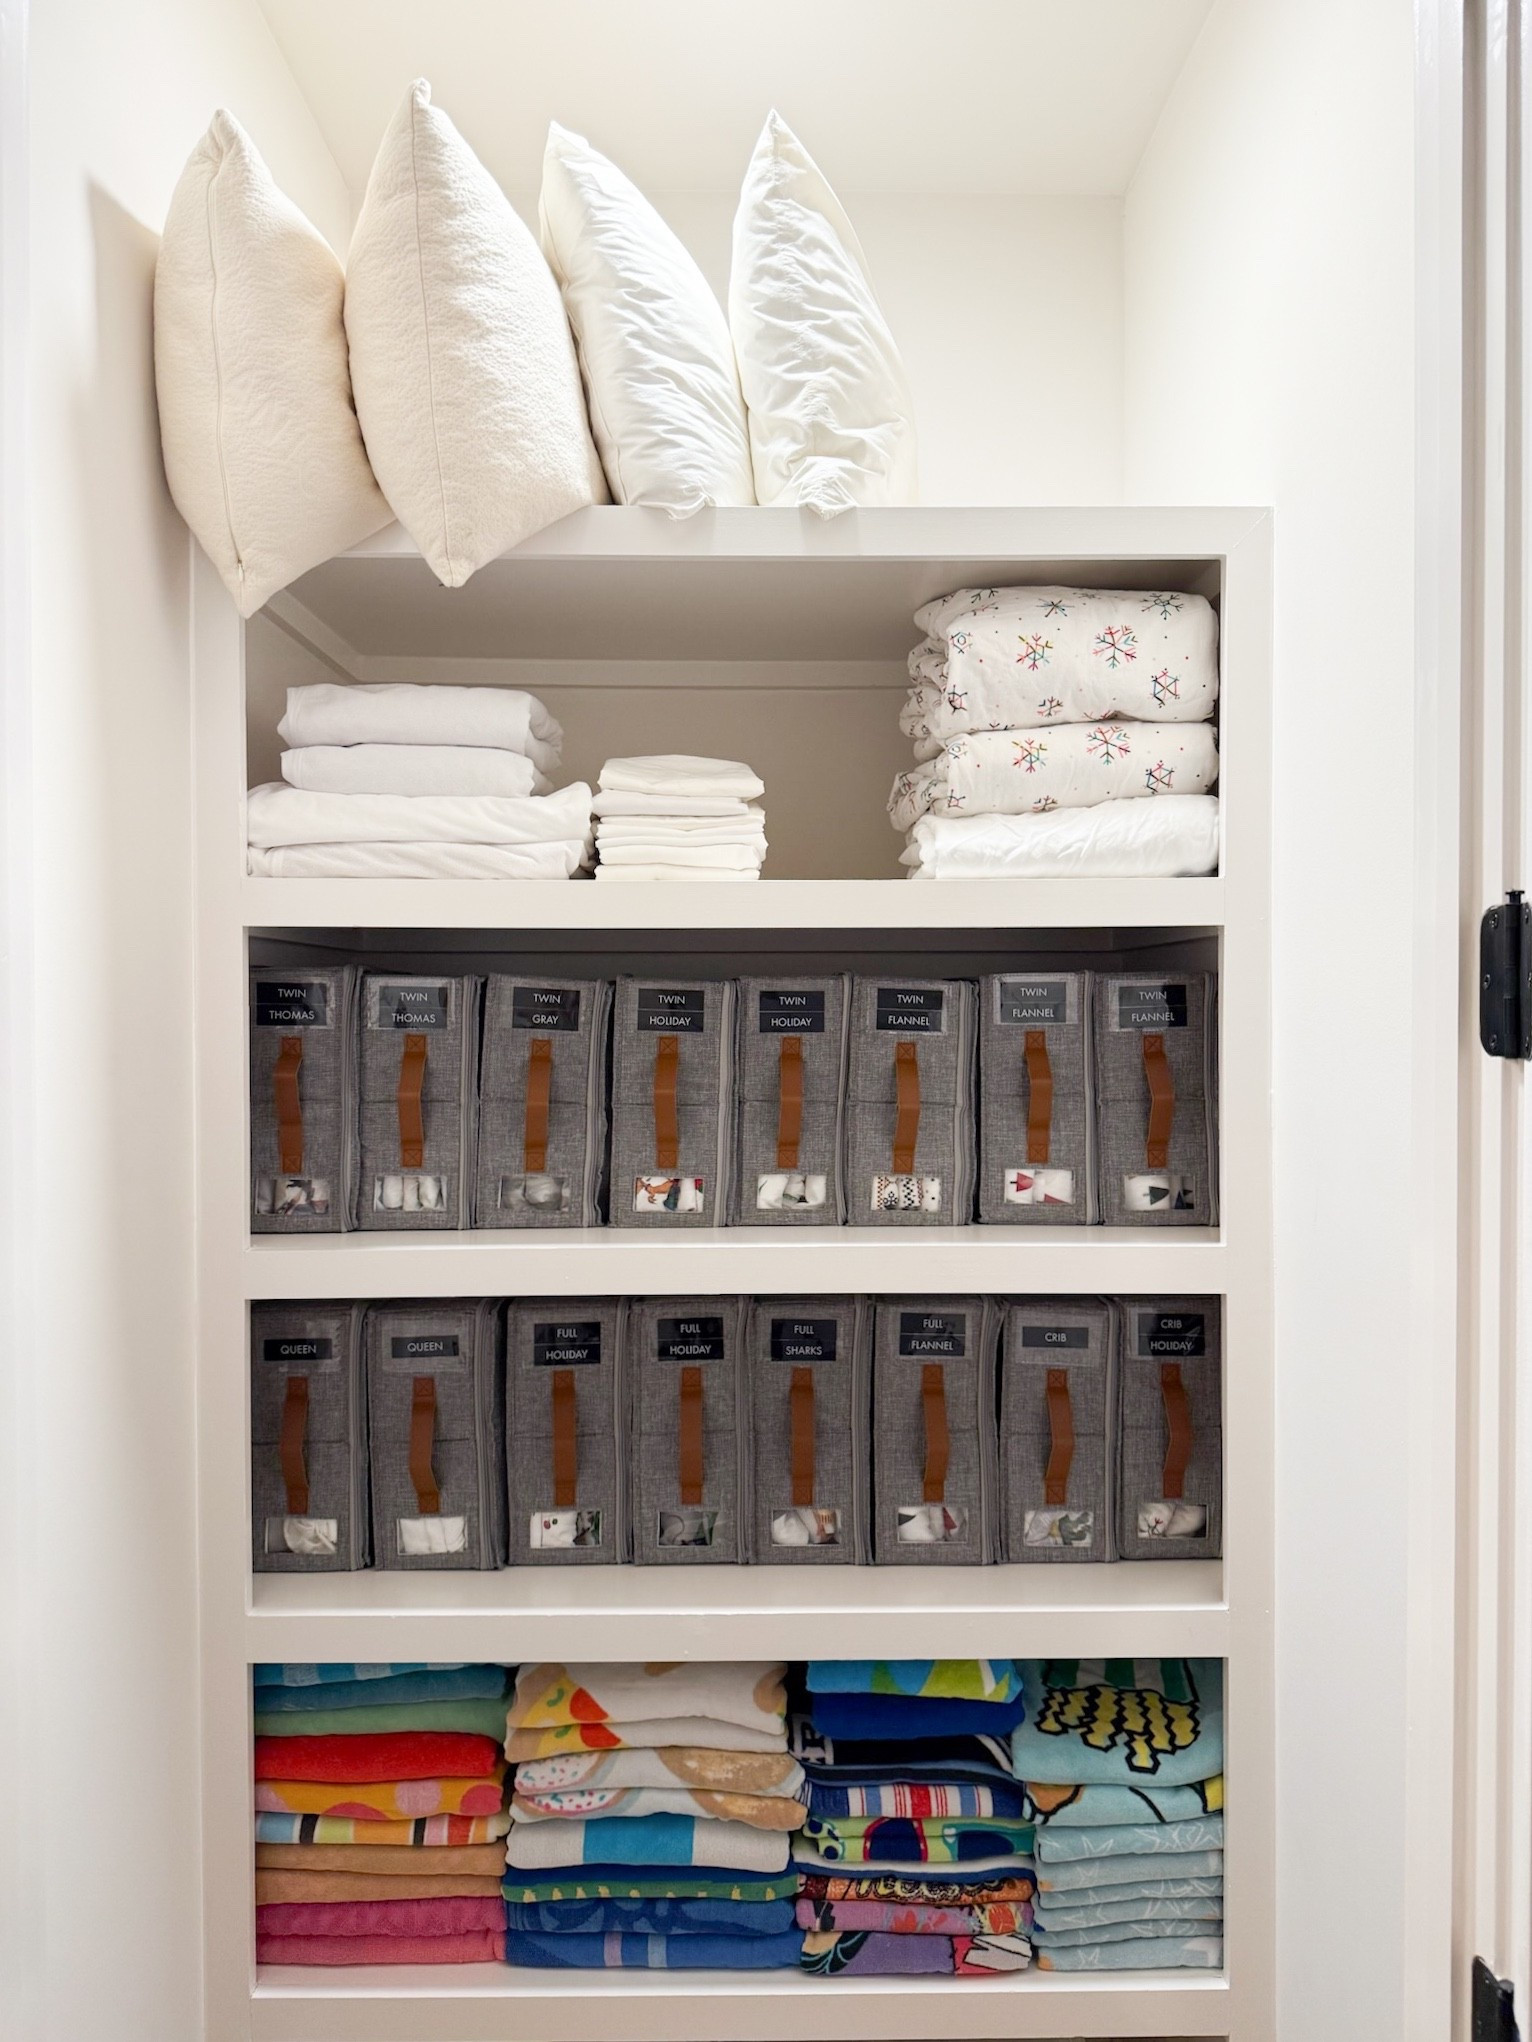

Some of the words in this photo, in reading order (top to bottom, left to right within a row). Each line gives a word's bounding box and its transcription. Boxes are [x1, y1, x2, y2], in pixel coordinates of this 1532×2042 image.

[278, 988, 307, 998] TWIN
[400, 992, 428, 1001] TWIN
[1020, 988, 1047, 997] TWIN
[1138, 991, 1167, 1001] TWIN
[533, 993, 561, 1004] TWIN
[658, 995, 686, 1005] TWIN
[779, 996, 806, 1006] TWIN
[897, 994, 924, 1004] TWIN
[269, 1010, 315, 1020] THOMAS
[1012, 1008, 1054, 1018] FLANNEL
[1131, 1012, 1175, 1022] FLANNEL
[391, 1013, 436, 1024] THOMAS
[532, 1014, 559, 1025] GRAY
[649, 1016, 691, 1026] HOLIDAY
[771, 1017, 812, 1027] HOLIDAY
[888, 1015, 930, 1026] FLANNEL
[680, 1324, 700, 1334] FULL
[923, 1319, 943, 1329] FULL
[1160, 1319, 1182, 1329] CRIB
[557, 1328, 578, 1338] FULL
[794, 1325, 814, 1335] FULL
[1045, 1332, 1067, 1343] CRIB
[280, 1344, 317, 1355] QUEEN
[407, 1341, 443, 1352] QUEEN
[670, 1345, 712, 1356] HOLIDAY
[785, 1345, 822, 1356] SHARKS
[911, 1340, 953, 1351] FLANNEL
[1150, 1341, 1192, 1351] HOLIDAY
[546, 1349, 588, 1361] HOLIDAY
